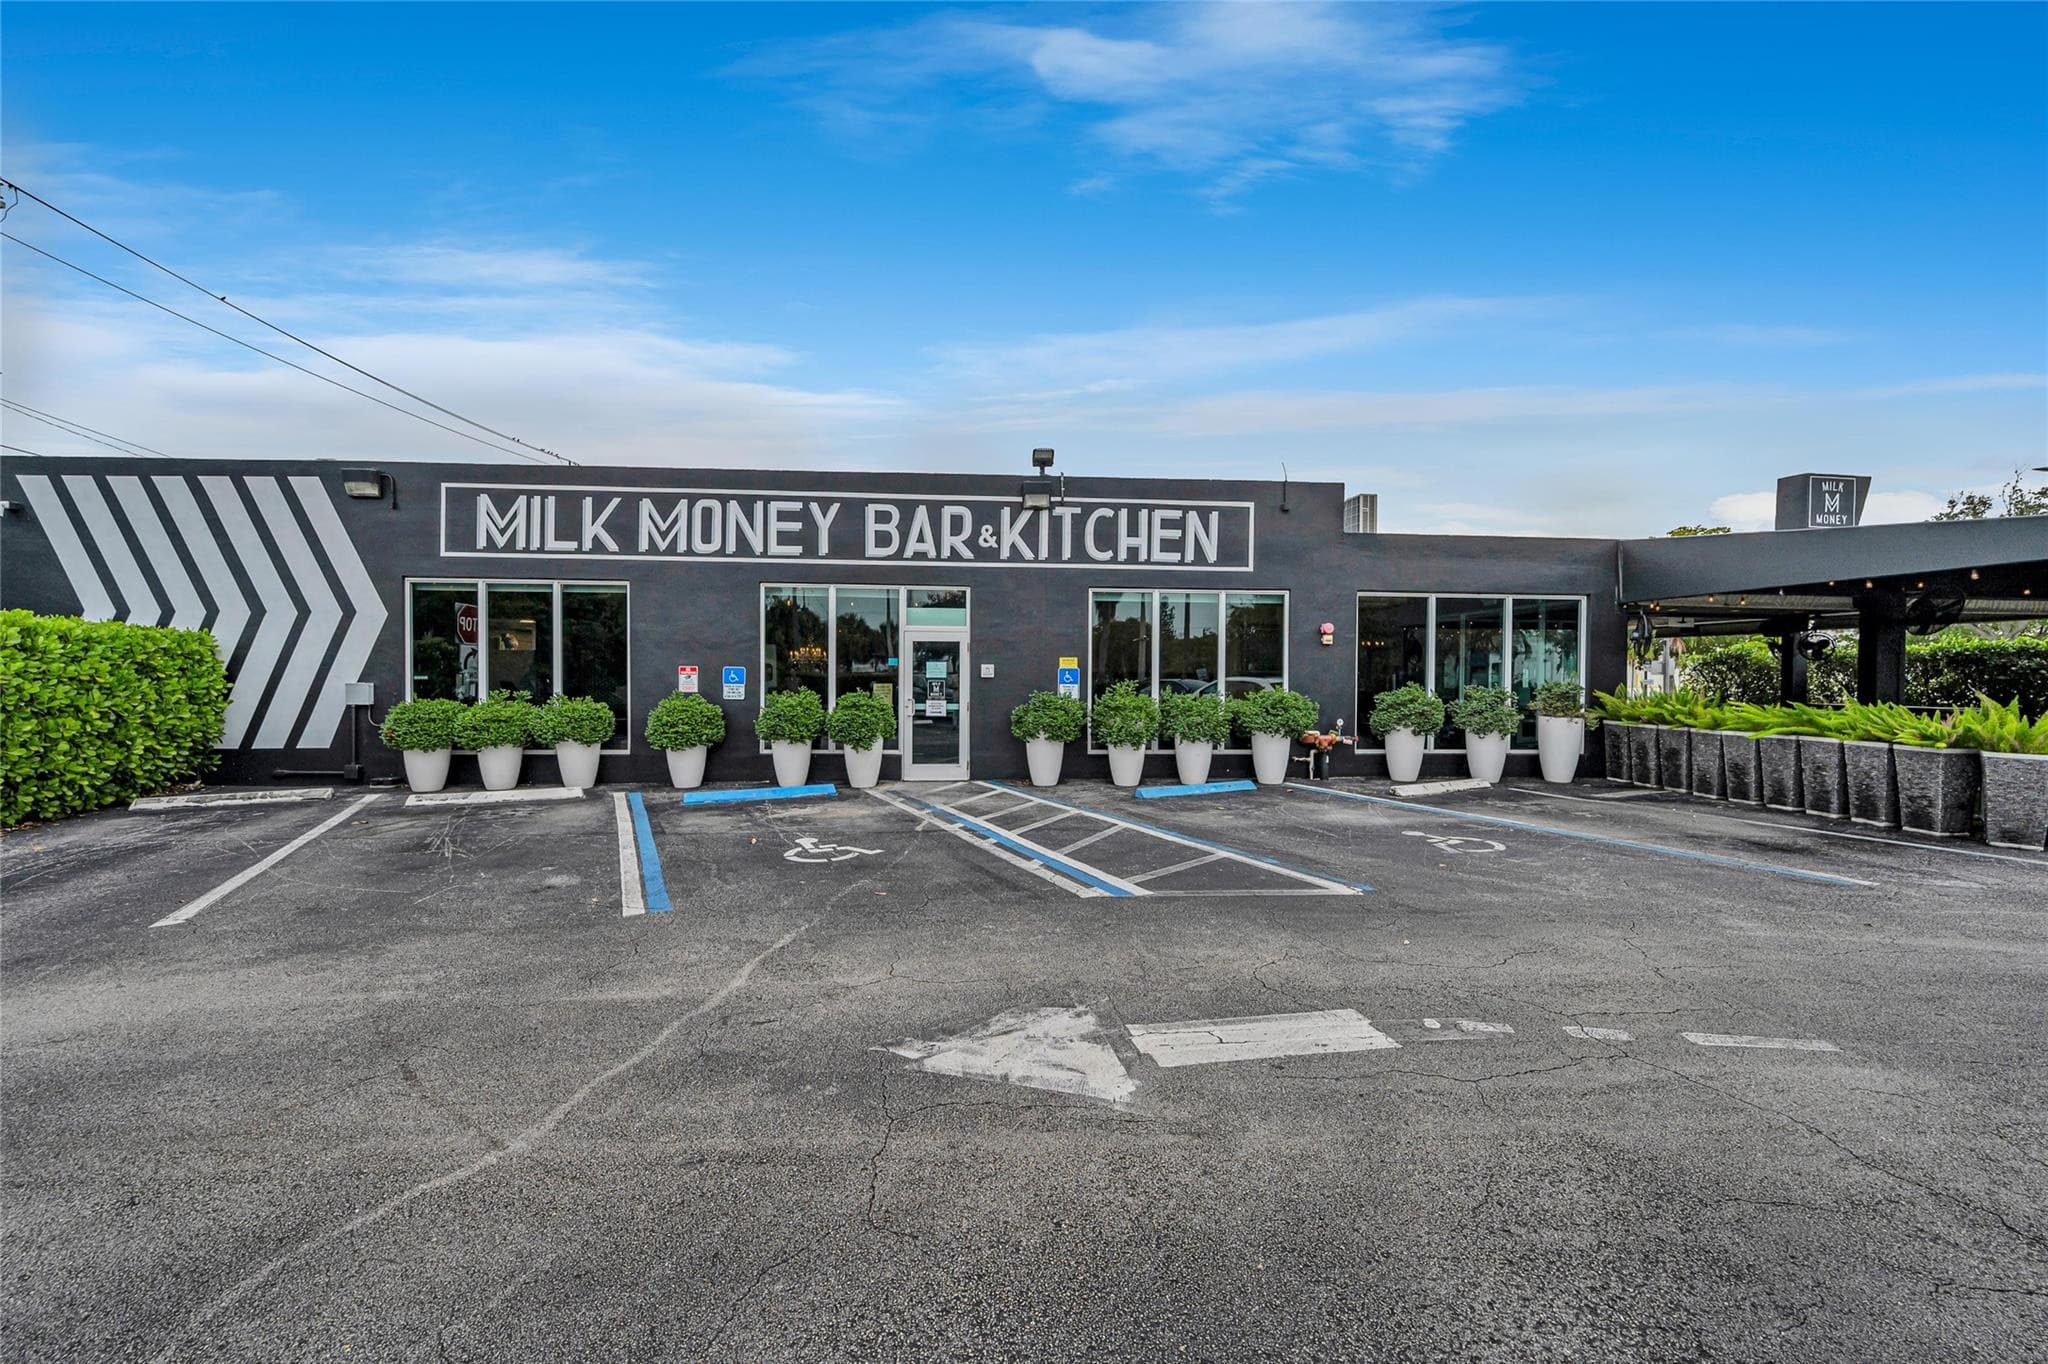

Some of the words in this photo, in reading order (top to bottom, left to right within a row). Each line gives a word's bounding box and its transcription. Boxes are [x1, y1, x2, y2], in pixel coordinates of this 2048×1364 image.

[1822, 481, 1844, 492] MILK
[1825, 493, 1840, 512] M
[475, 494, 622, 552] MILK
[637, 498, 840, 556] MONEY
[1816, 514, 1847, 525] MONEY
